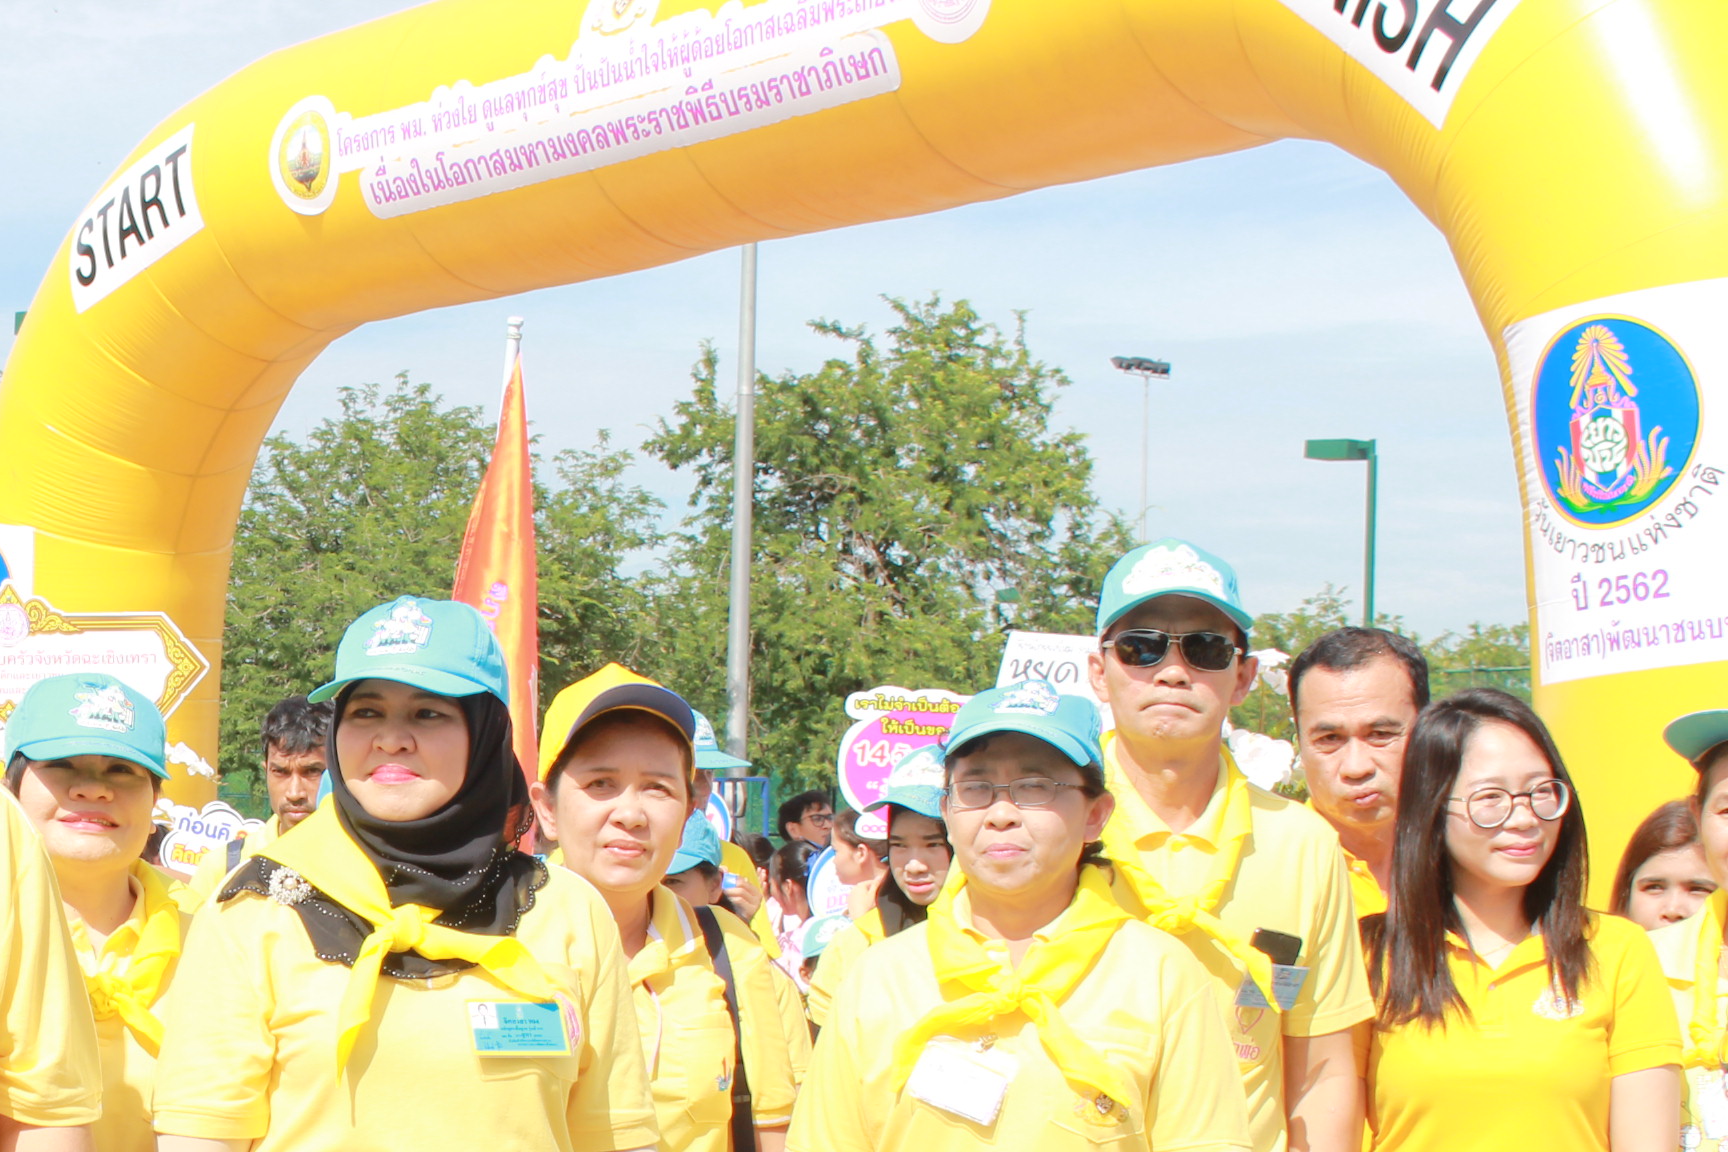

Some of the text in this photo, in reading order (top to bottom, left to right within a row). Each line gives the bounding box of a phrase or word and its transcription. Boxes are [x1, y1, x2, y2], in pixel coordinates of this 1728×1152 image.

[336, 120, 395, 157] โครงการ
[400, 116, 427, 142] พม.
[75, 143, 188, 288] START
[1534, 463, 1726, 564] วันเยาวชนแห่งชาติ
[1570, 568, 1671, 612] ปี 2562
[1544, 615, 1728, 670] (จิตอาสา)พัฒนาชนบ
[854, 693, 960, 714] เราไม่จำเป็นต้อ
